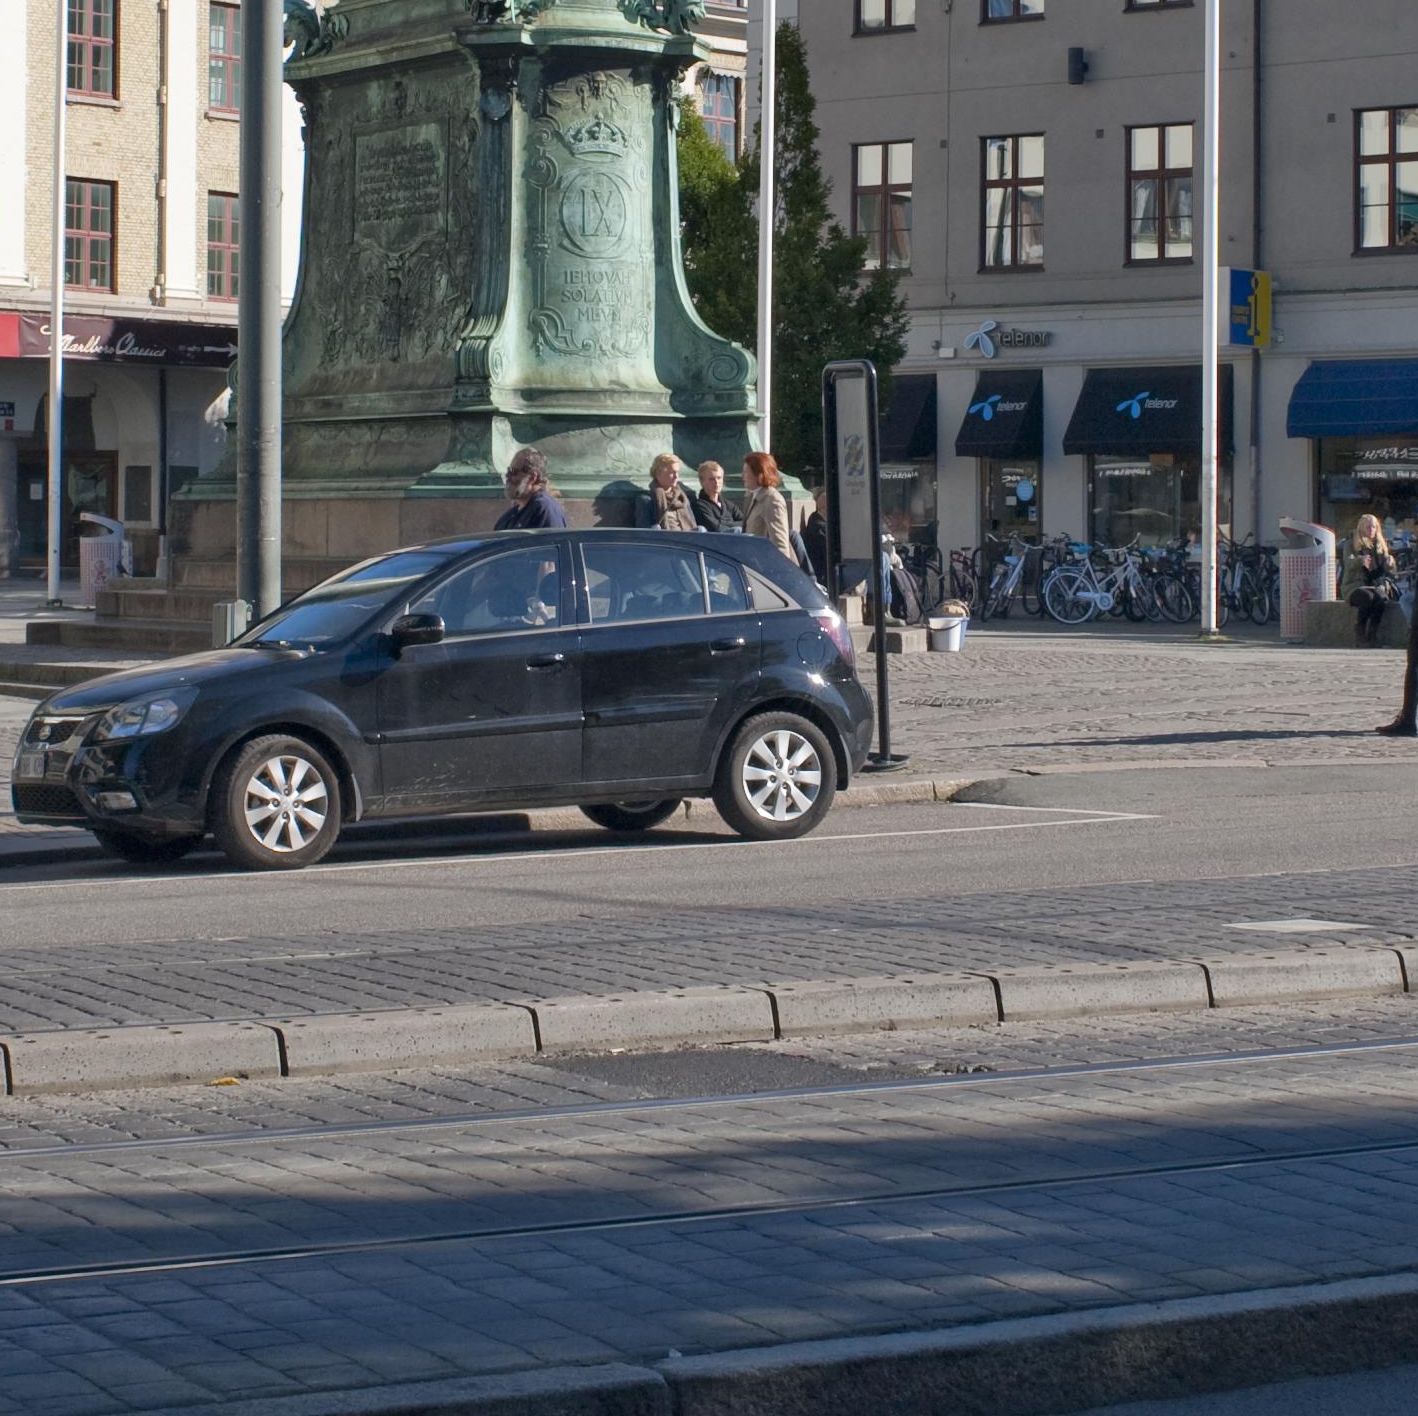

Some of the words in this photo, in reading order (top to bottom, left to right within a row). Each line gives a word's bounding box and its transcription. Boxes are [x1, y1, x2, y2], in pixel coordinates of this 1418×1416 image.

[564, 270, 630, 285] IEHOVAH
[997, 329, 1049, 346] telenor
[997, 401, 1028, 412] telenor
[1144, 398, 1178, 409] telenor
